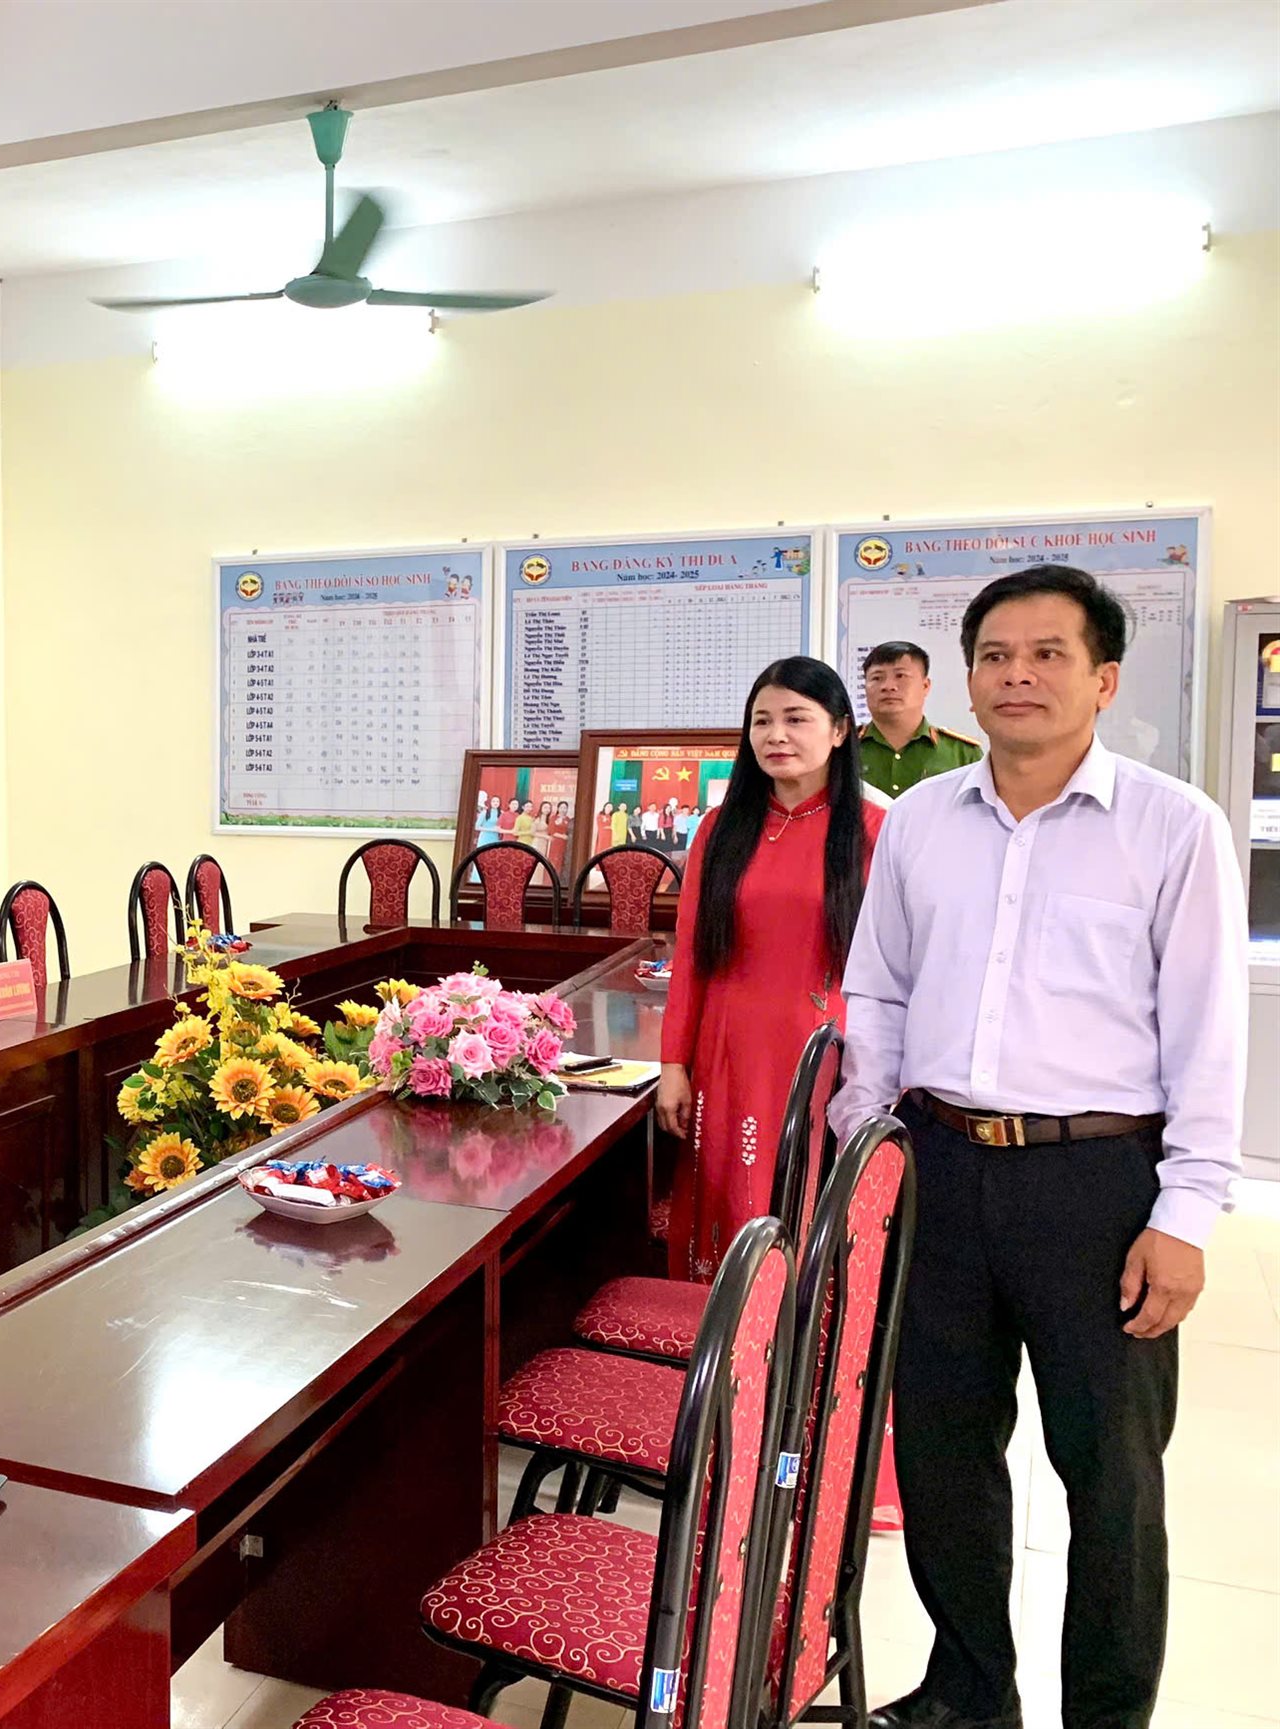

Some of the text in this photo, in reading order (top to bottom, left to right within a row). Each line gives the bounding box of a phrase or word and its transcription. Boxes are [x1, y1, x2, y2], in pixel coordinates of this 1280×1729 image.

[945, 538, 981, 551] THEO
[1088, 532, 1116, 548] HỌC
[1123, 530, 1156, 543] SINH
[656, 552, 674, 568] KÝ
[681, 556, 704, 567] THI
[406, 574, 431, 585] SINH
[680, 569, 700, 579] 2025
